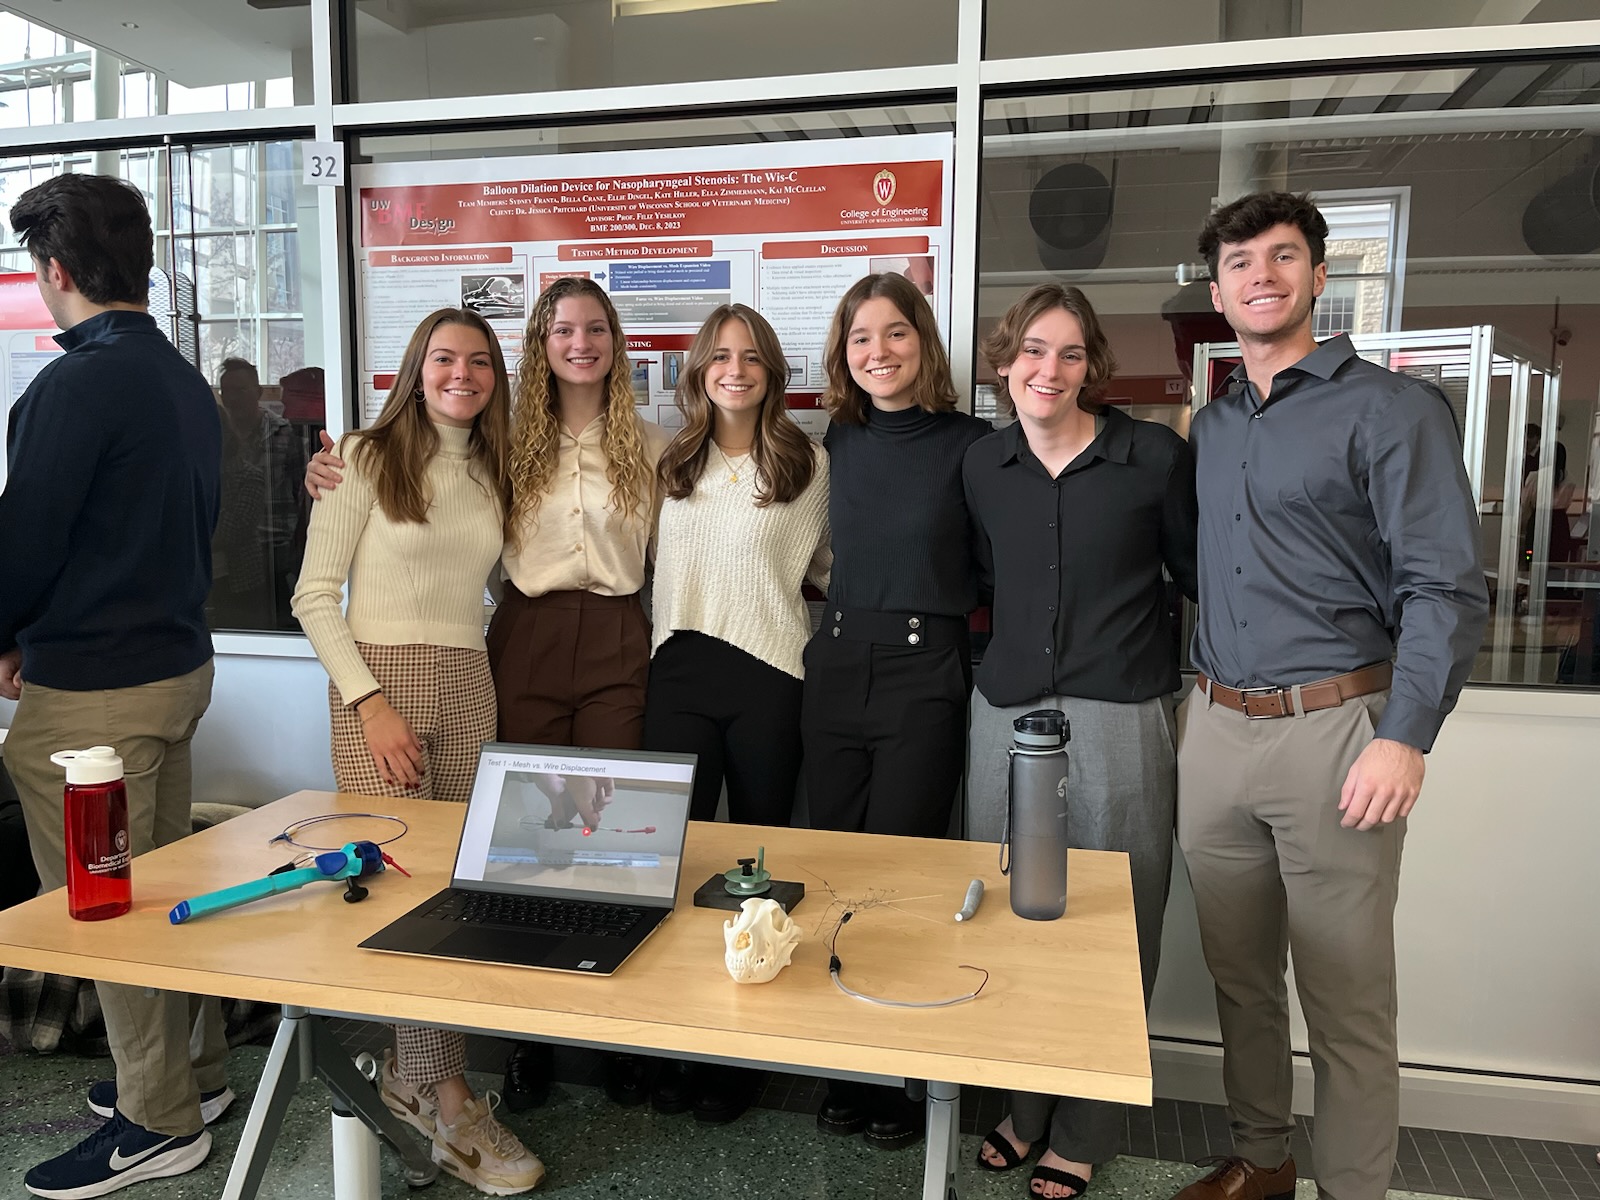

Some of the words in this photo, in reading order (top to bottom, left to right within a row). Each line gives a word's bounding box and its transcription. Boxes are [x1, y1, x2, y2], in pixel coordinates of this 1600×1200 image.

[312, 156, 336, 177] 32
[483, 185, 518, 196] Balloon
[520, 183, 558, 194] Dilation
[561, 182, 593, 192] Device
[596, 180, 610, 190] for
[613, 176, 692, 190] Nasopharyngeal
[694, 174, 738, 185] Stenosis:
[742, 173, 762, 183] The
[764, 172, 798, 182] Wis-C
[477, 199, 508, 207] MEMBERS:
[628, 192, 652, 200] DINGEL,
[720, 188, 768, 196] ZIMMERMANN,
[371, 200, 391, 211] UW
[588, 204, 627, 213] (UNIVERSITY
[754, 197, 790, 206] MEDICINE)
[840, 209, 869, 219] College
[871, 208, 880, 217] of
[882, 207, 928, 217] Engineering
[410, 218, 456, 232] Design
[571, 248, 603, 257] TESTING
[605, 247, 638, 256] METHOD
[641, 246, 698, 255] DEVELOPMENT
[821, 245, 868, 253] DISCUSSION
[391, 254, 439, 263] BACKGROUND
[441, 253, 489, 261] INFORMATION
[561, 764, 606, 773] Displacement
[88, 859, 122, 870] Biomedical
